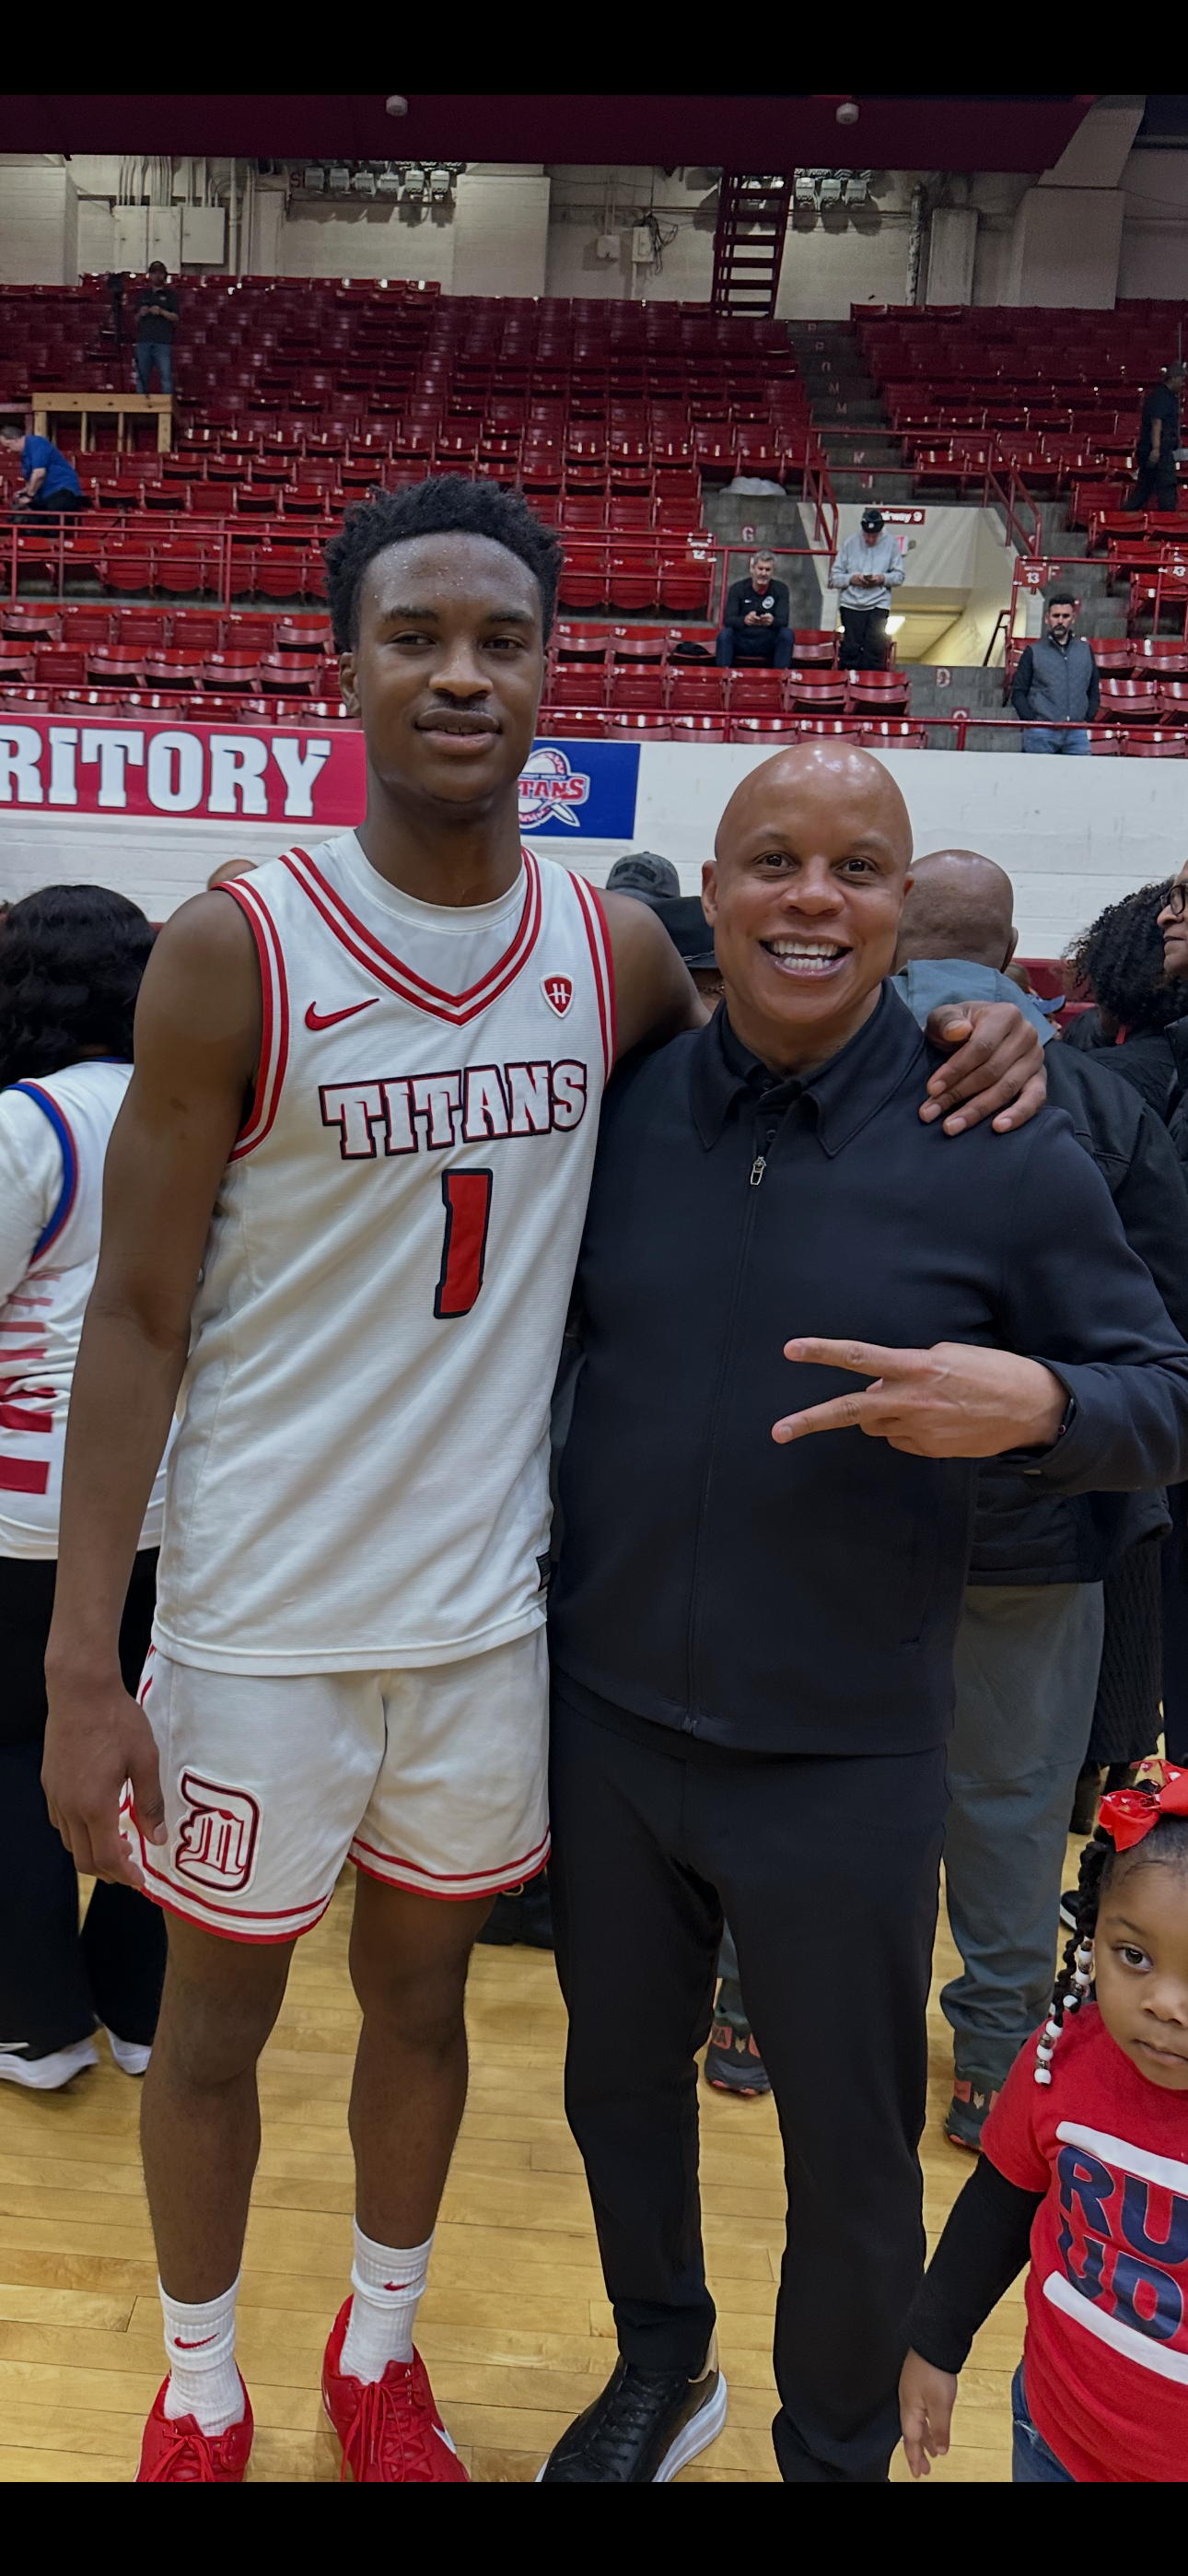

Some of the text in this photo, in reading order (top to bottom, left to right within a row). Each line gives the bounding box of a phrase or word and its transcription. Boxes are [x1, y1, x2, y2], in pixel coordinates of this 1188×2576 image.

[913, 510, 923, 522] 9
[741, 525, 754, 543] G
[1026, 572, 1041, 584] 13
[936, 668, 950, 687] D
[0, 724, 332, 817] RITORY
[518, 778, 585, 801] TANS
[319, 1059, 588, 1160] TITANS
[434, 1168, 494, 1319] 1
